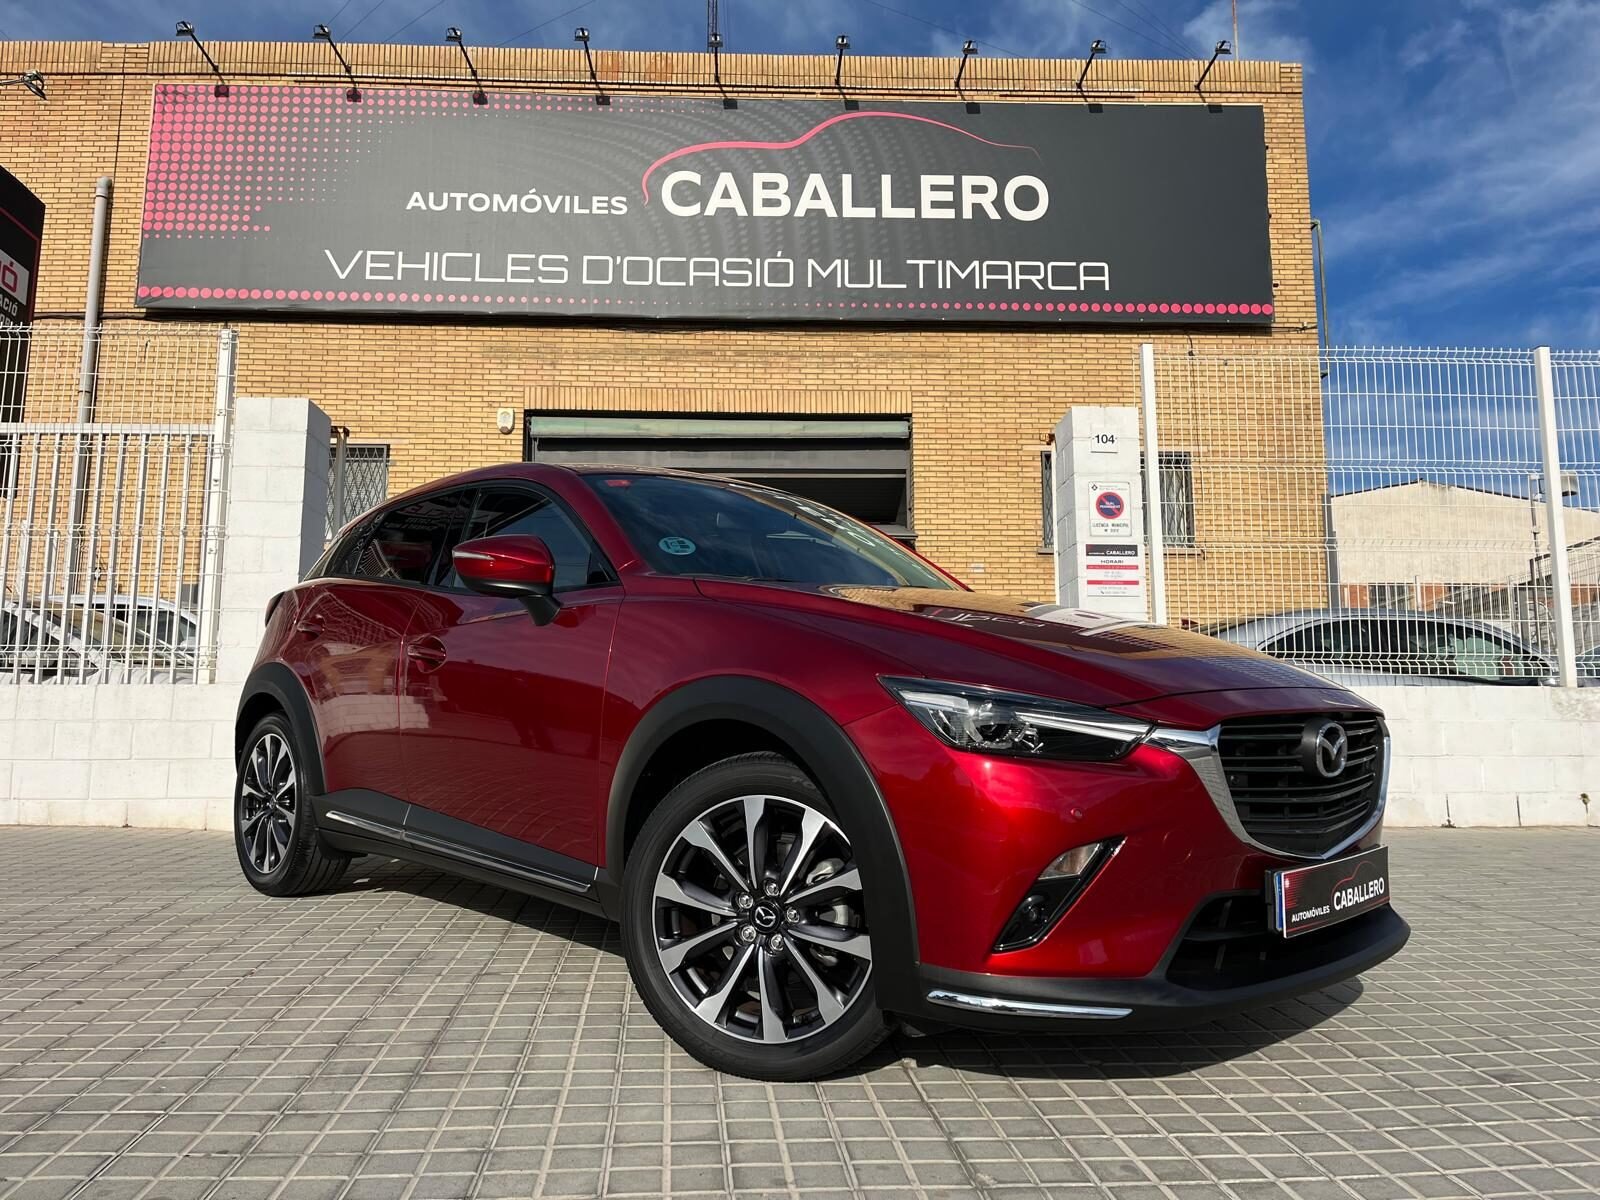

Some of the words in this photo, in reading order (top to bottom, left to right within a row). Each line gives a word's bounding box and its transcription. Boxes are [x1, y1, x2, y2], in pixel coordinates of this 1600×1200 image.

[405, 187, 628, 215] AUTOMÓVILES
[661, 170, 1050, 222] CABALLERO
[324, 249, 569, 284] VEHICLES
[582, 251, 794, 287] D'OCASIÓ
[807, 258, 1110, 291] MULTIMARCA
[1095, 434, 1115, 444] 104
[1291, 905, 1330, 923] AUTOMÓVILES
[1333, 877, 1385, 911] CABALLERO
